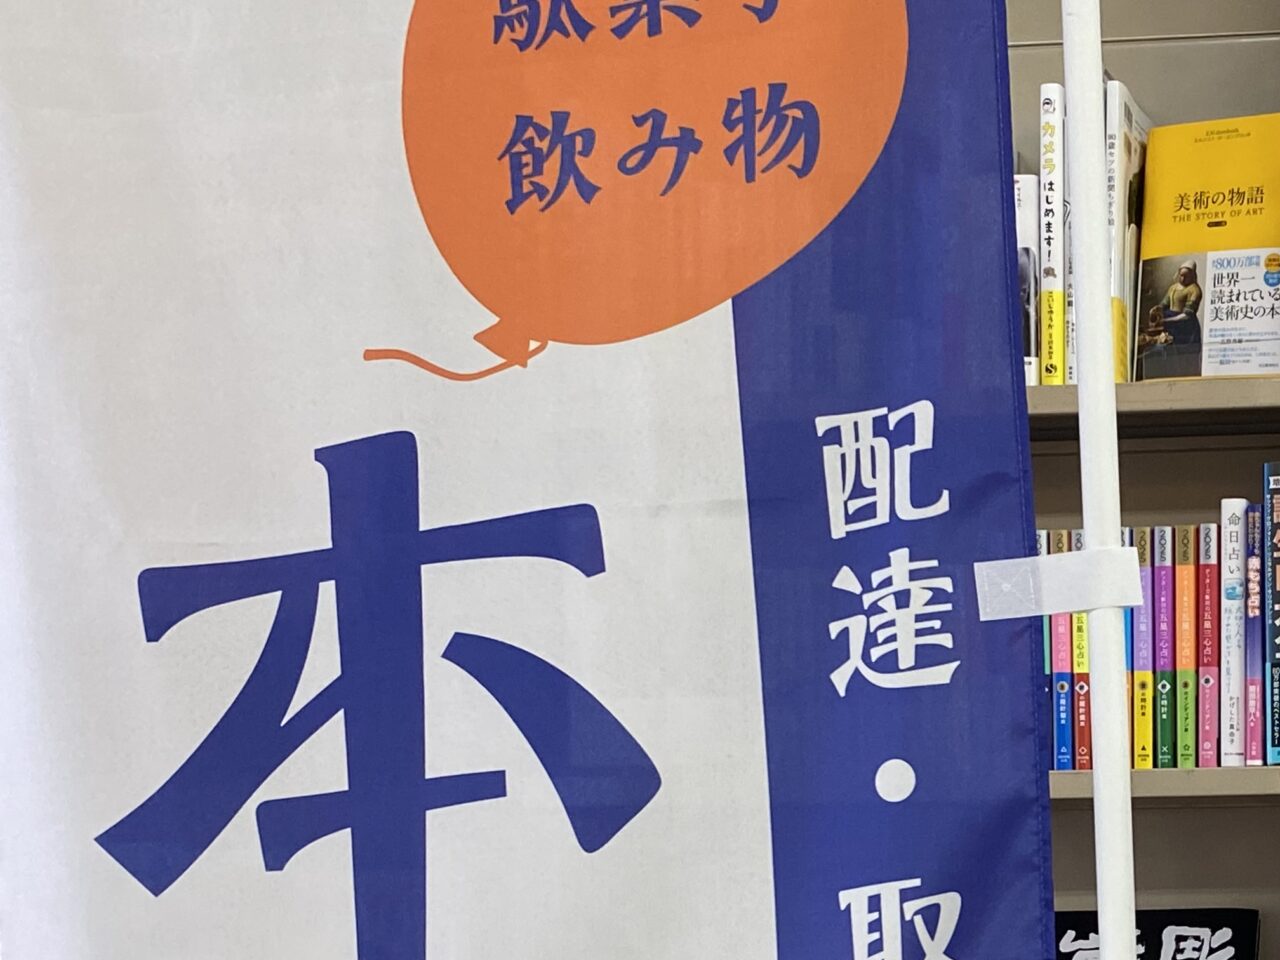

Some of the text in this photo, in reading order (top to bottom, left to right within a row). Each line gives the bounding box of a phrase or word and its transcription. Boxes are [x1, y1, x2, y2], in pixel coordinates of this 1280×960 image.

[497, 82, 821, 215] 飲み物
[1172, 207, 1264, 223] THE STORY OF ART
[1174, 186, 1264, 211] 美術の物語
[1213, 271, 1256, 289] 世界一
[1210, 303, 1280, 321] 美術史の本
[1158, 529, 1168, 562] 2025
[1180, 528, 1190, 565] 2025
[1203, 527, 1212, 560] 2025
[1227, 512, 1241, 574] 命日占い
